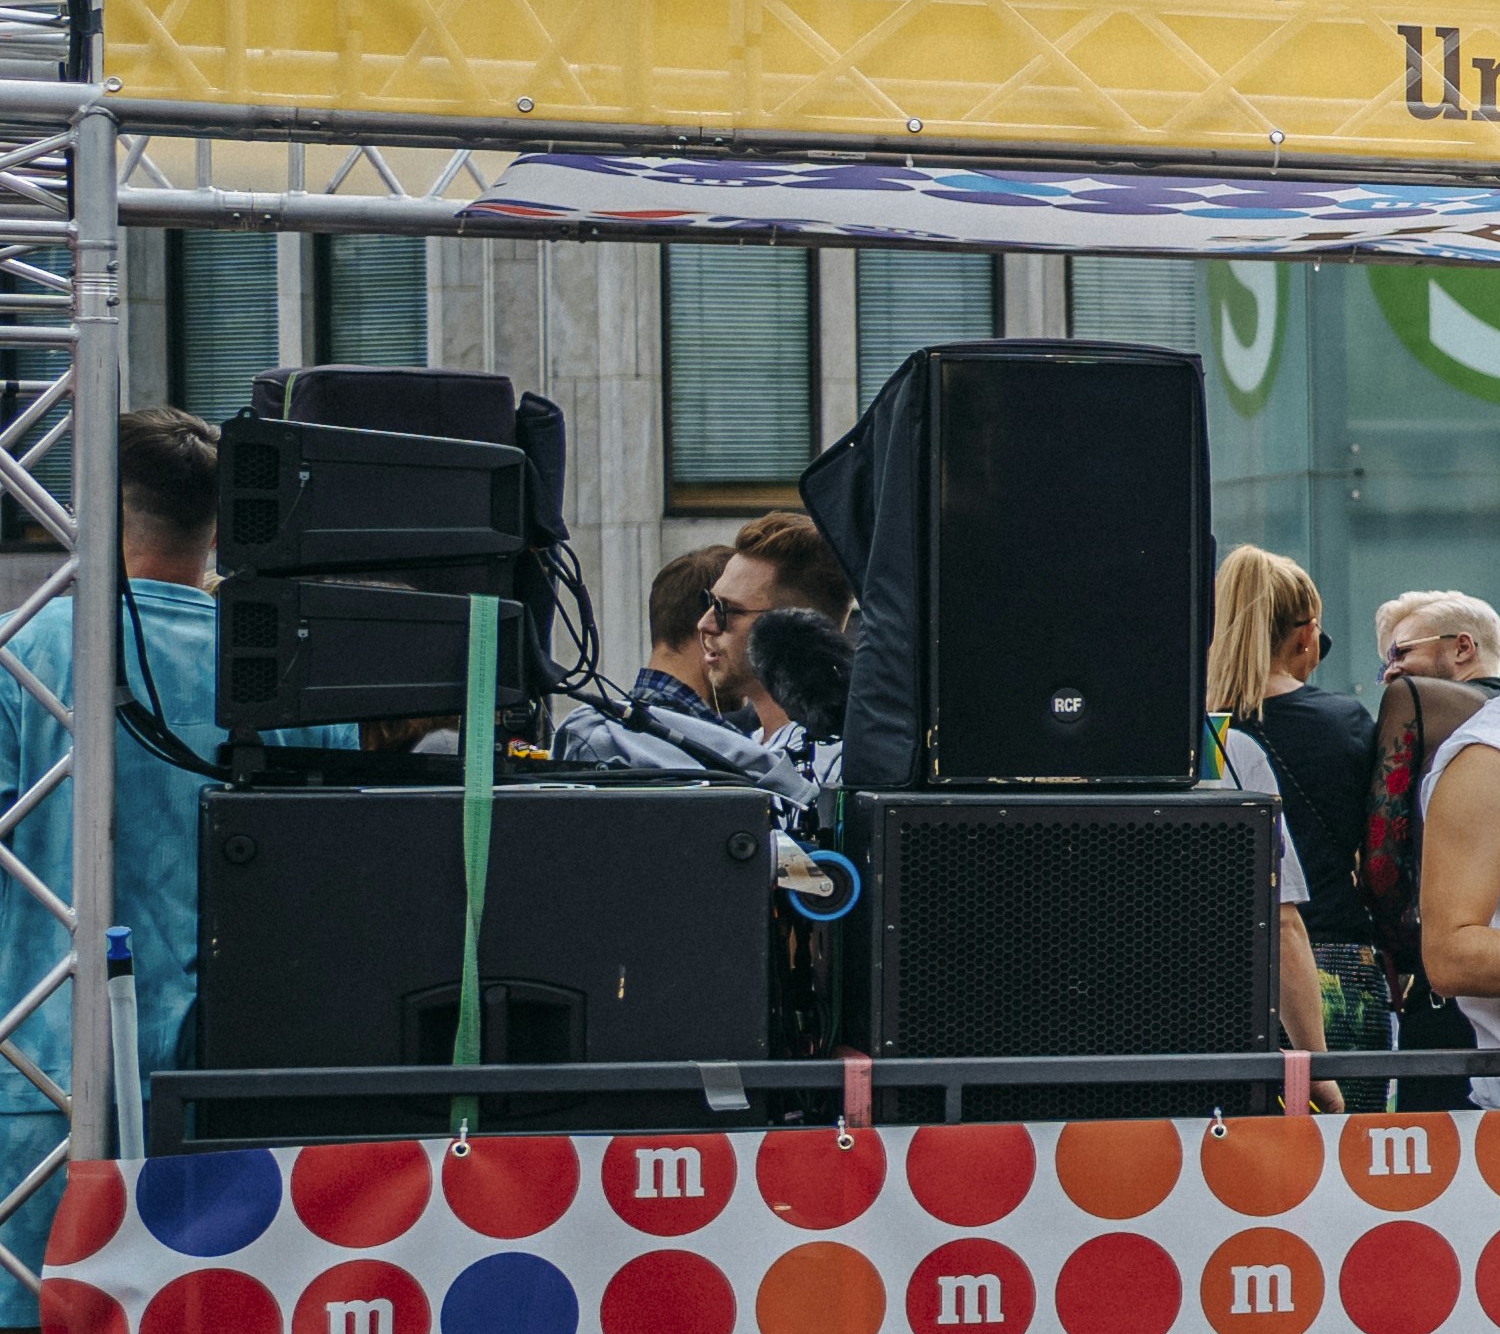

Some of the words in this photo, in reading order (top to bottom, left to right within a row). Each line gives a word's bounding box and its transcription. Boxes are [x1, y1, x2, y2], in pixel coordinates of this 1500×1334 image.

[1054, 697, 1082, 712] RCF
[634, 1147, 704, 1198] m
[1369, 1127, 1431, 1175] m
[938, 1274, 1004, 1324] m
[1231, 1264, 1294, 1314] m
